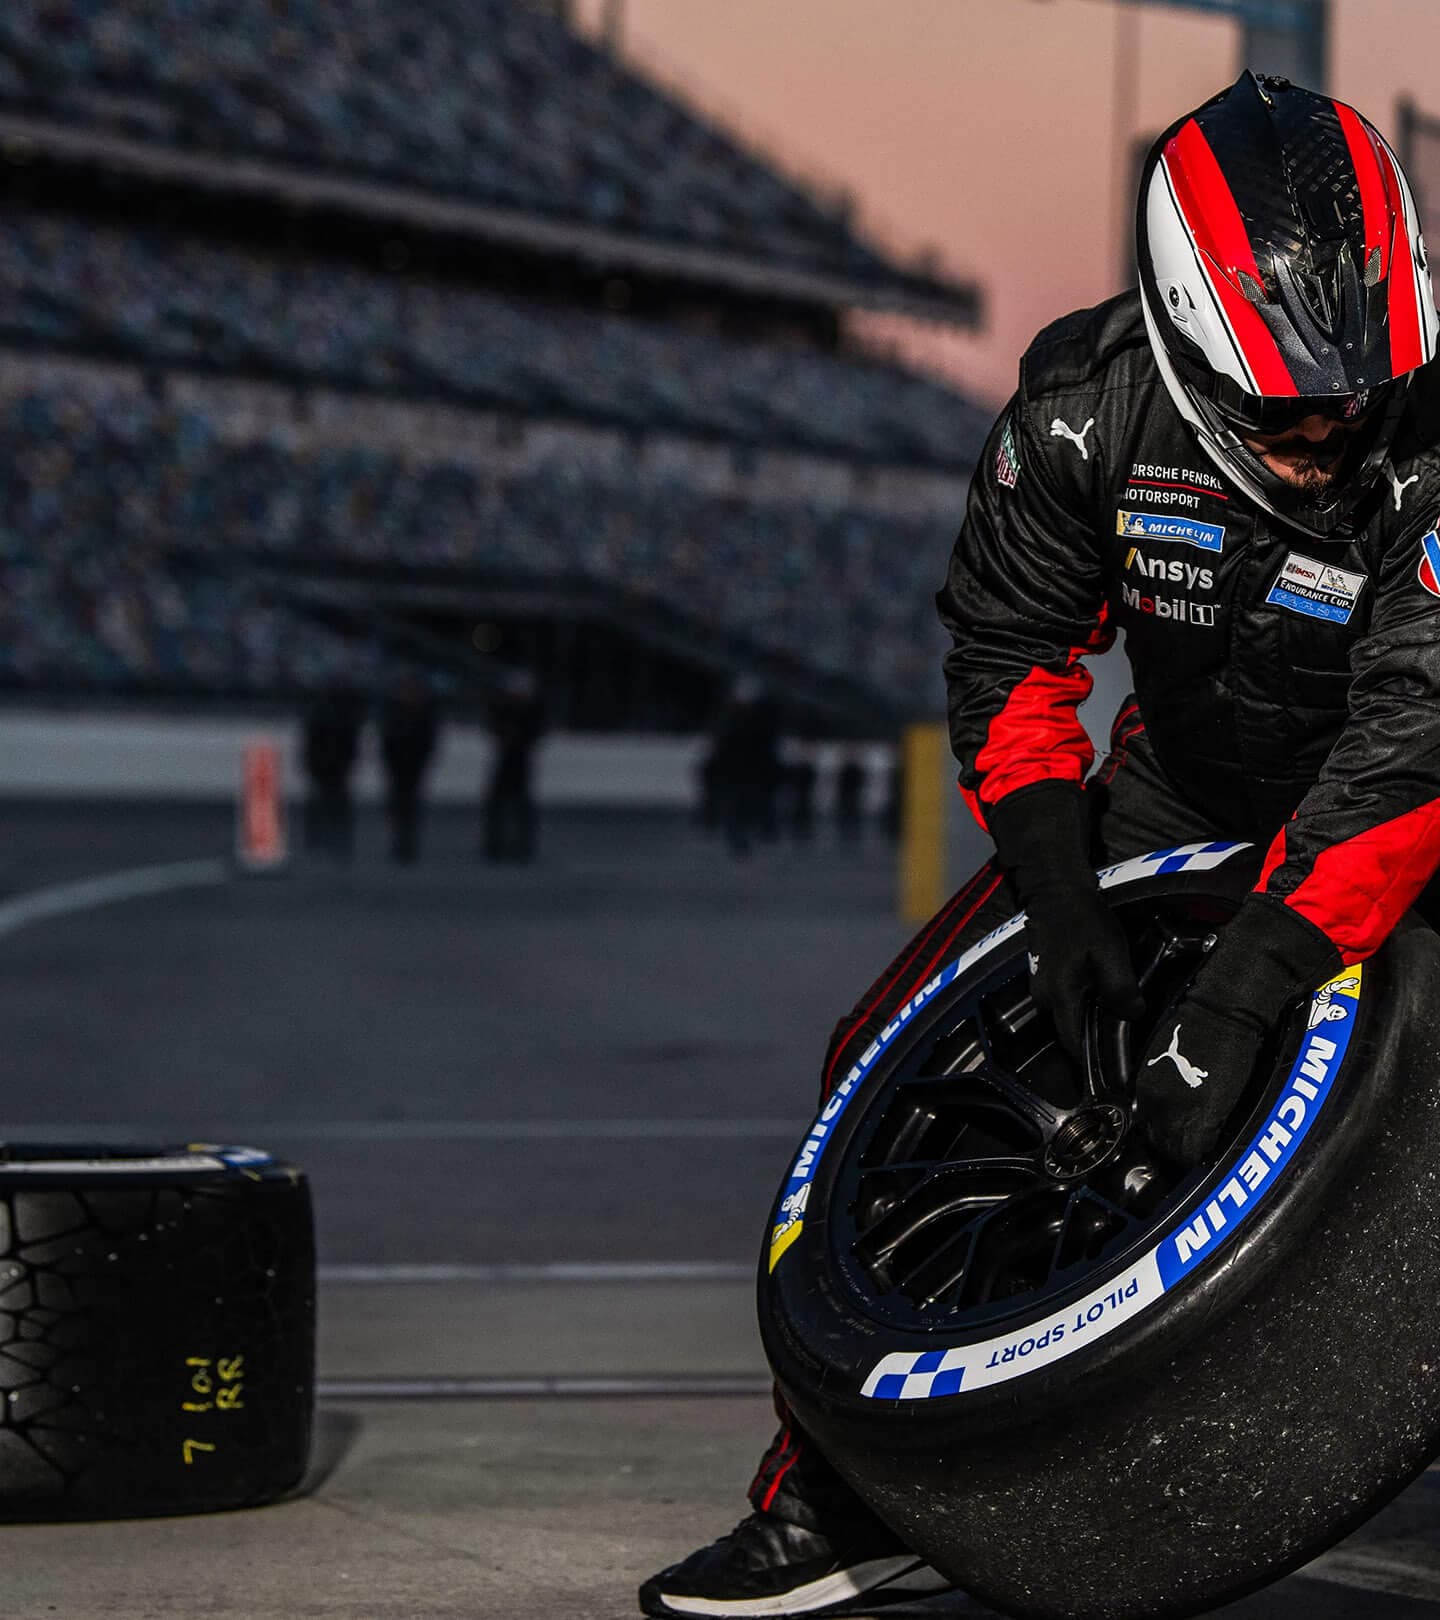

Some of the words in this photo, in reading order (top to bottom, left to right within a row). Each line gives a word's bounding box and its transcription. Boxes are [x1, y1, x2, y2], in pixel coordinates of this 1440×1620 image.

[1148, 522, 1214, 543] MICHELIN
[1125, 547, 1214, 590] Ansys
[1280, 579, 1329, 602] ENDURANCE
[1122, 582, 1186, 622] Mobil
[792, 973, 941, 1180] MICHELIN
[1175, 1034, 1338, 1263] MICHELIN
[1072, 1277, 1139, 1333] PILOT
[985, 1323, 1065, 1369] SPORT
[216, 1354, 244, 1409] RR
